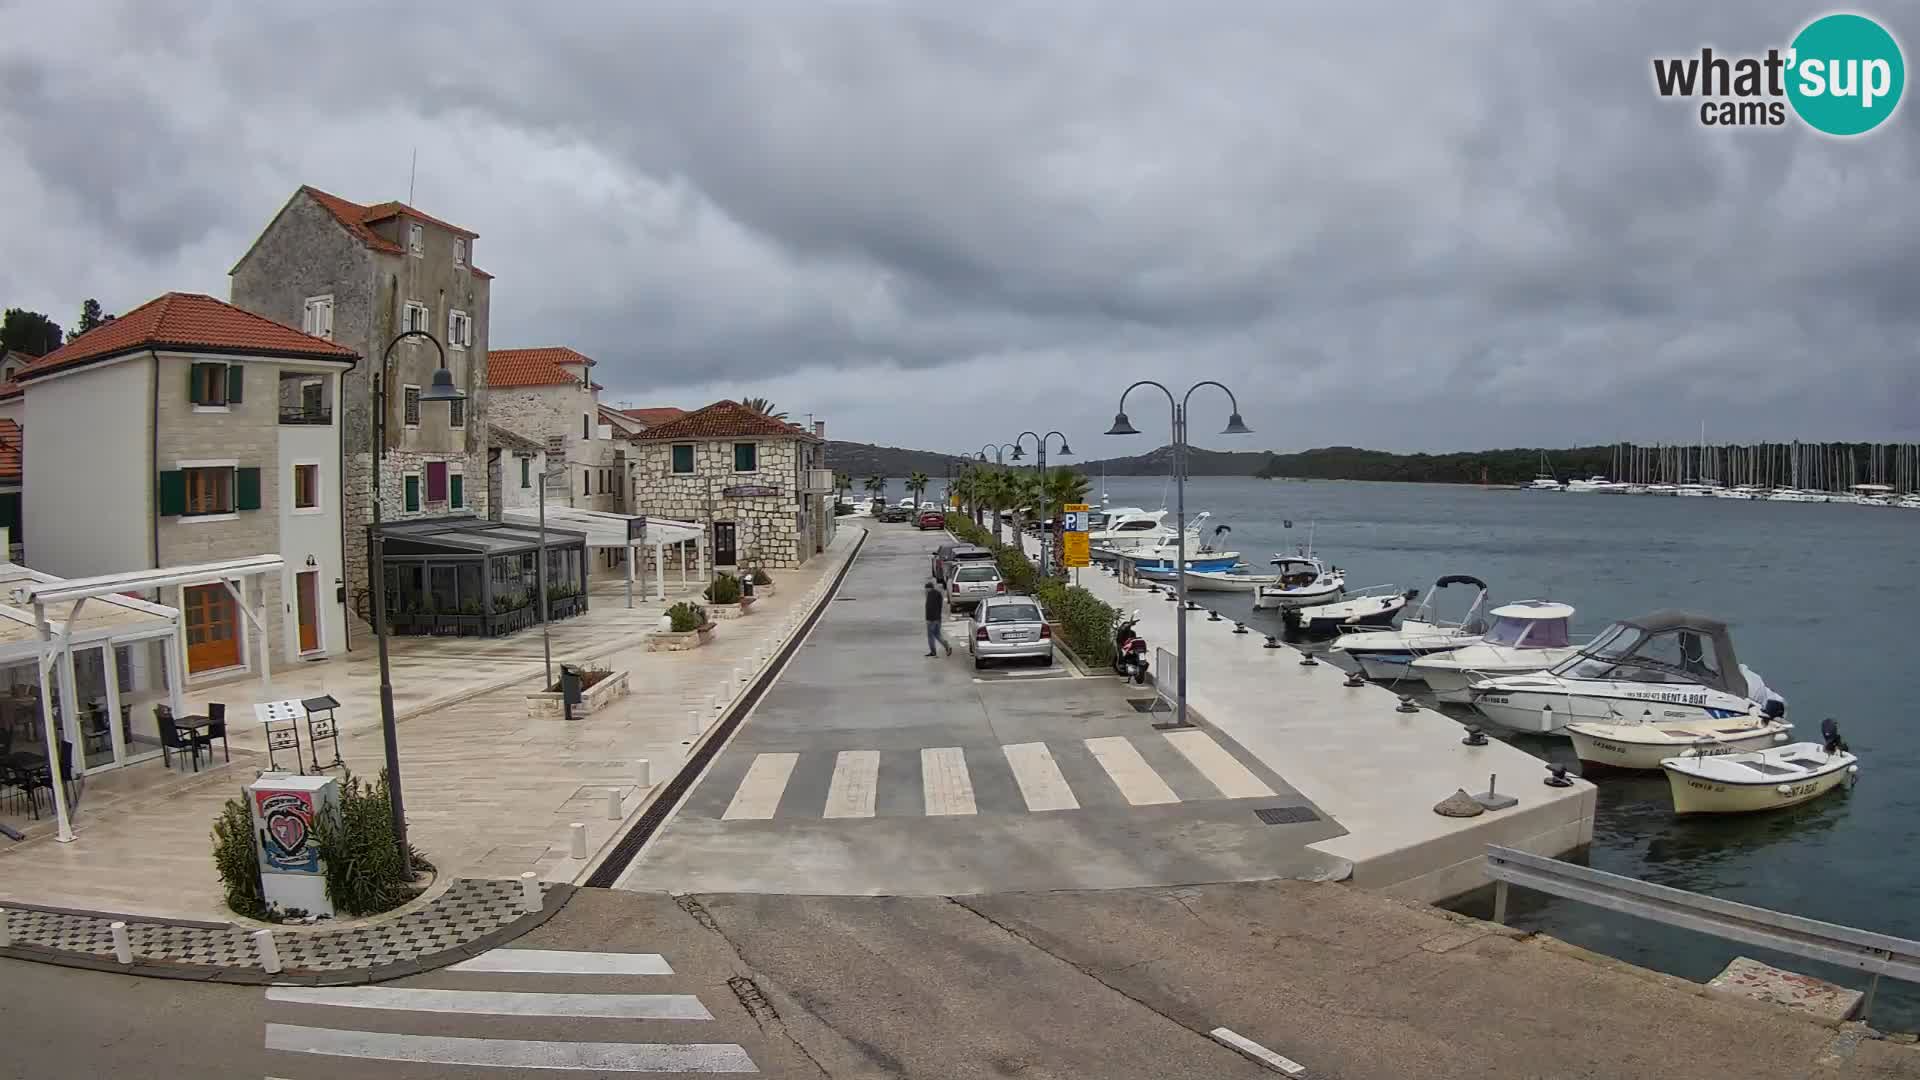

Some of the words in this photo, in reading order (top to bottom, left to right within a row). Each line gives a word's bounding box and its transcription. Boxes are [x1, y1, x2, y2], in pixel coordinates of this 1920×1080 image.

[1065, 514, 1076, 529] P
[1661, 692, 1681, 702] RENT
[1682, 694, 1688, 703] A
[1688, 694, 1708, 705] BOAT
